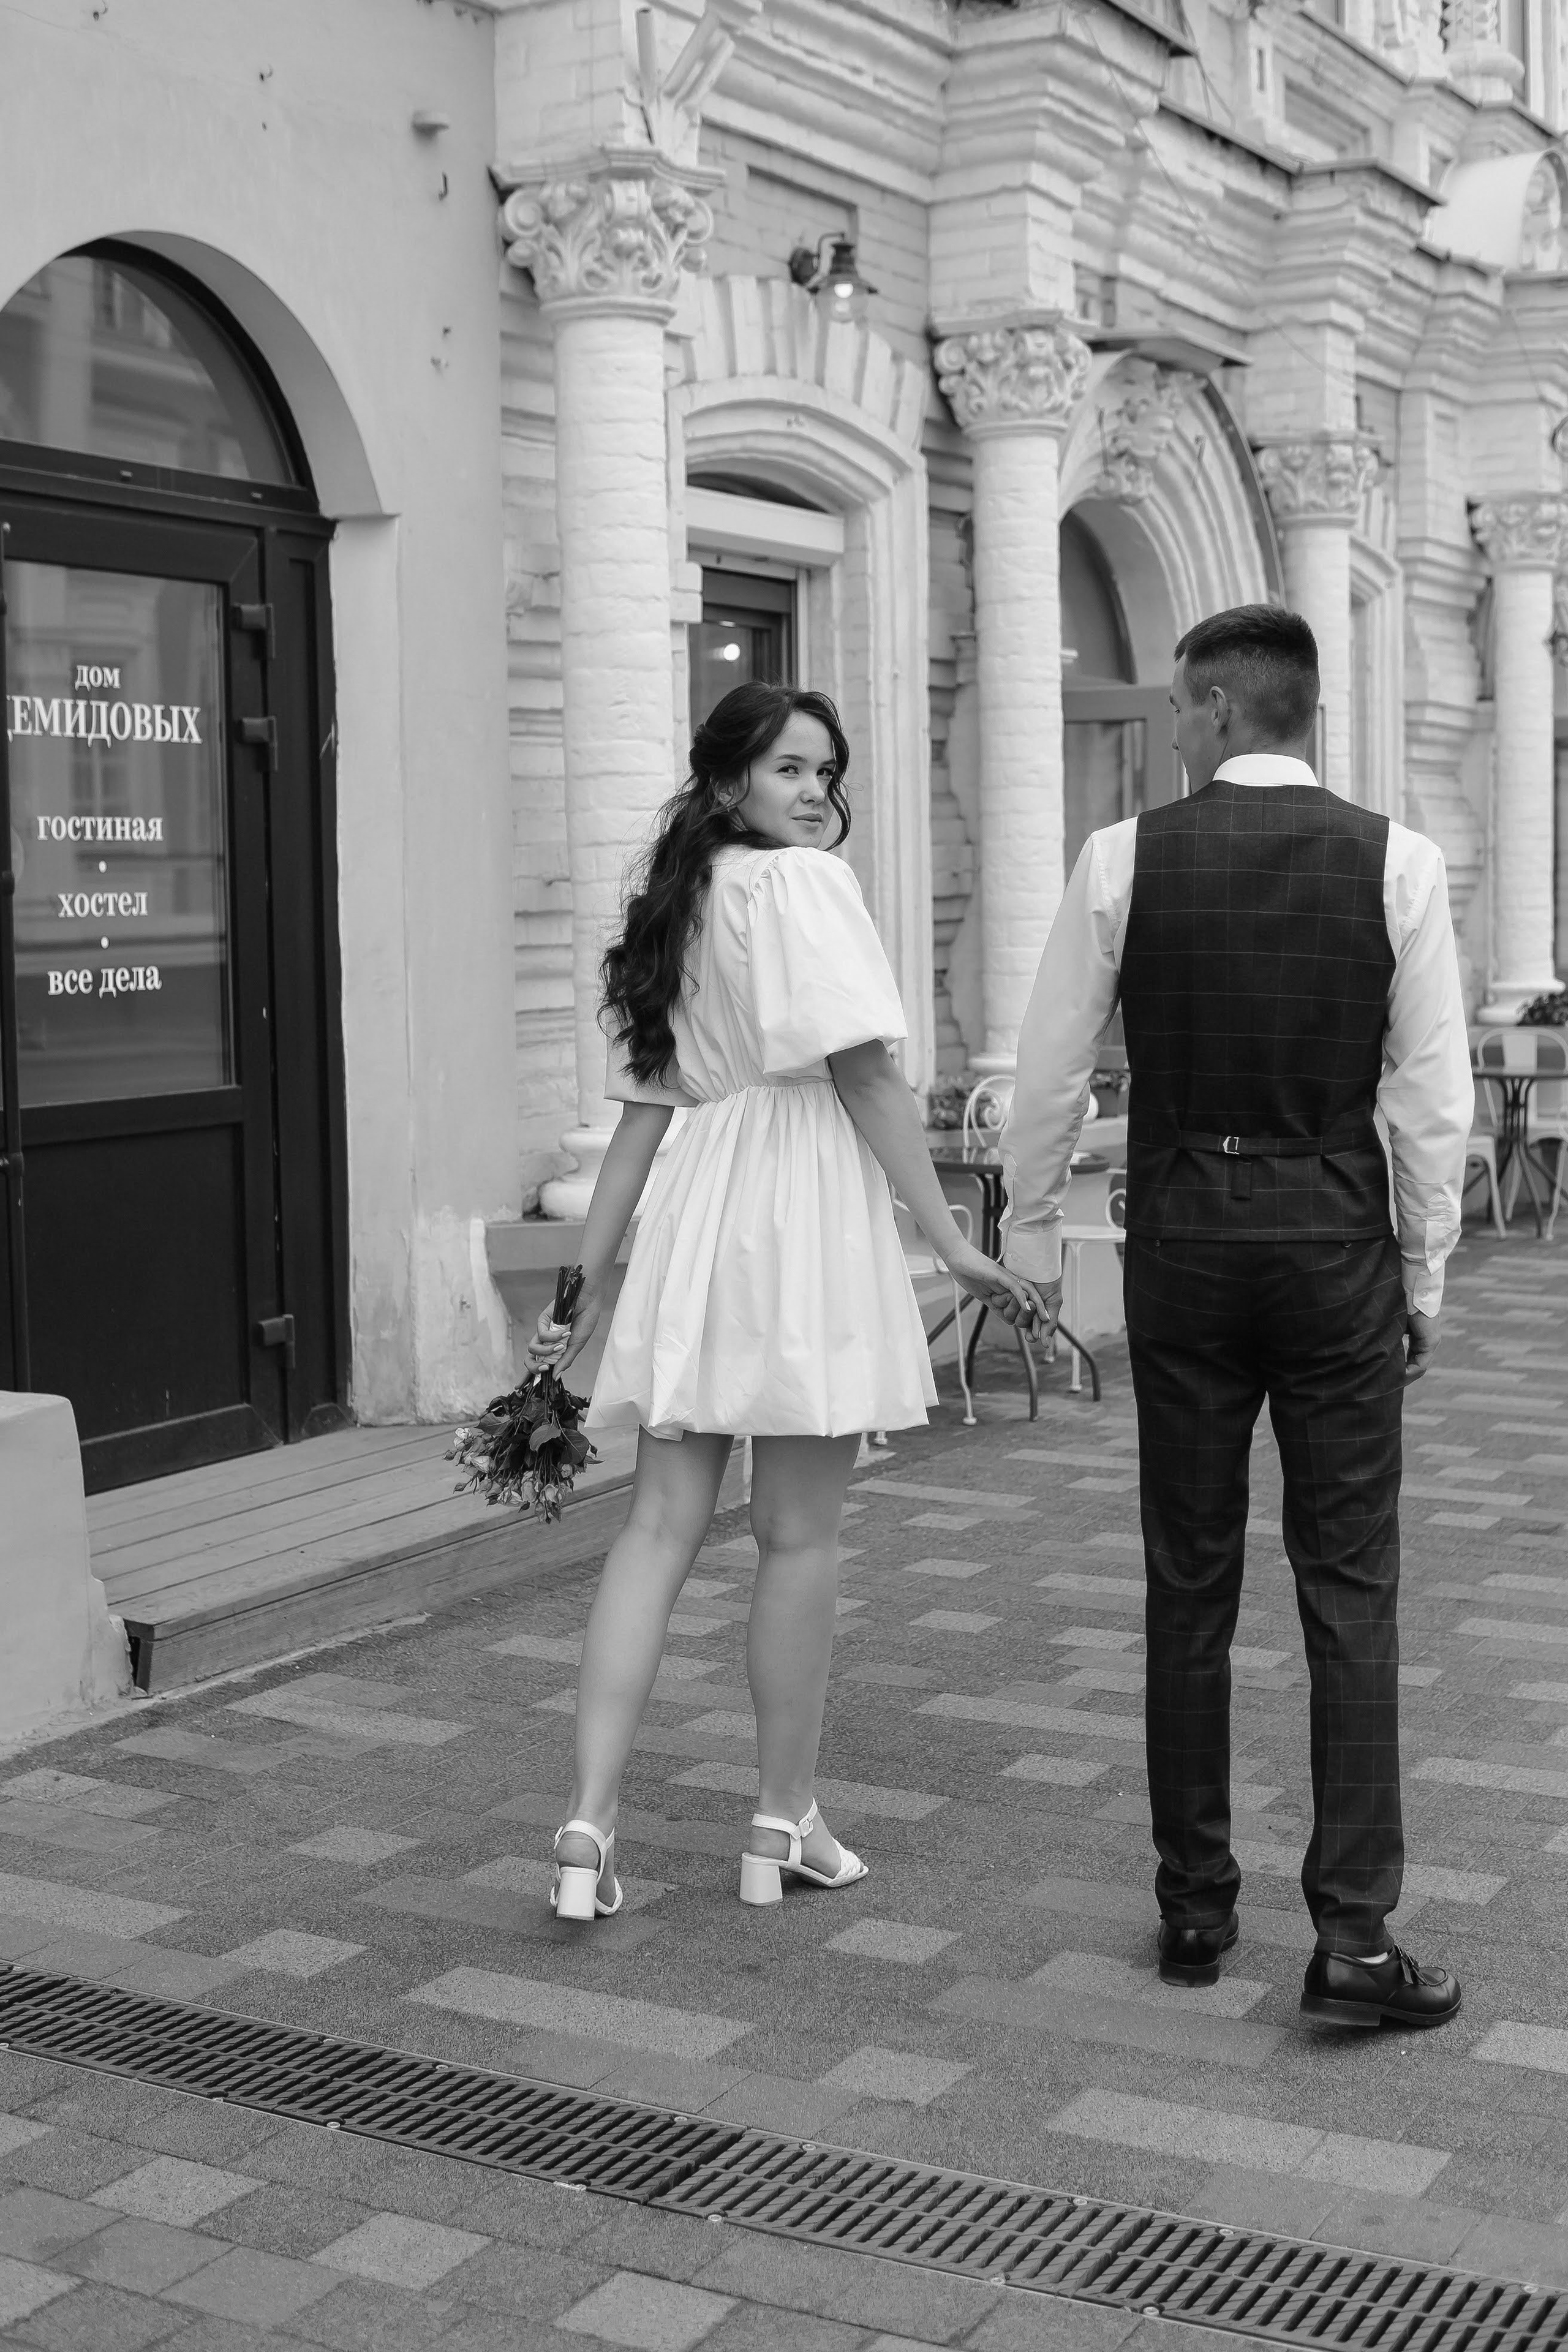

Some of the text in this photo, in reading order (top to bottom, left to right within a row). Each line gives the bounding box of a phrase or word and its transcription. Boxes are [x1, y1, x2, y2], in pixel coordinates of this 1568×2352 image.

[6, 695, 203, 748] ЕМИДОВЫХ
[37, 815, 164, 842] гостиная
[99, 965, 162, 999] дела
